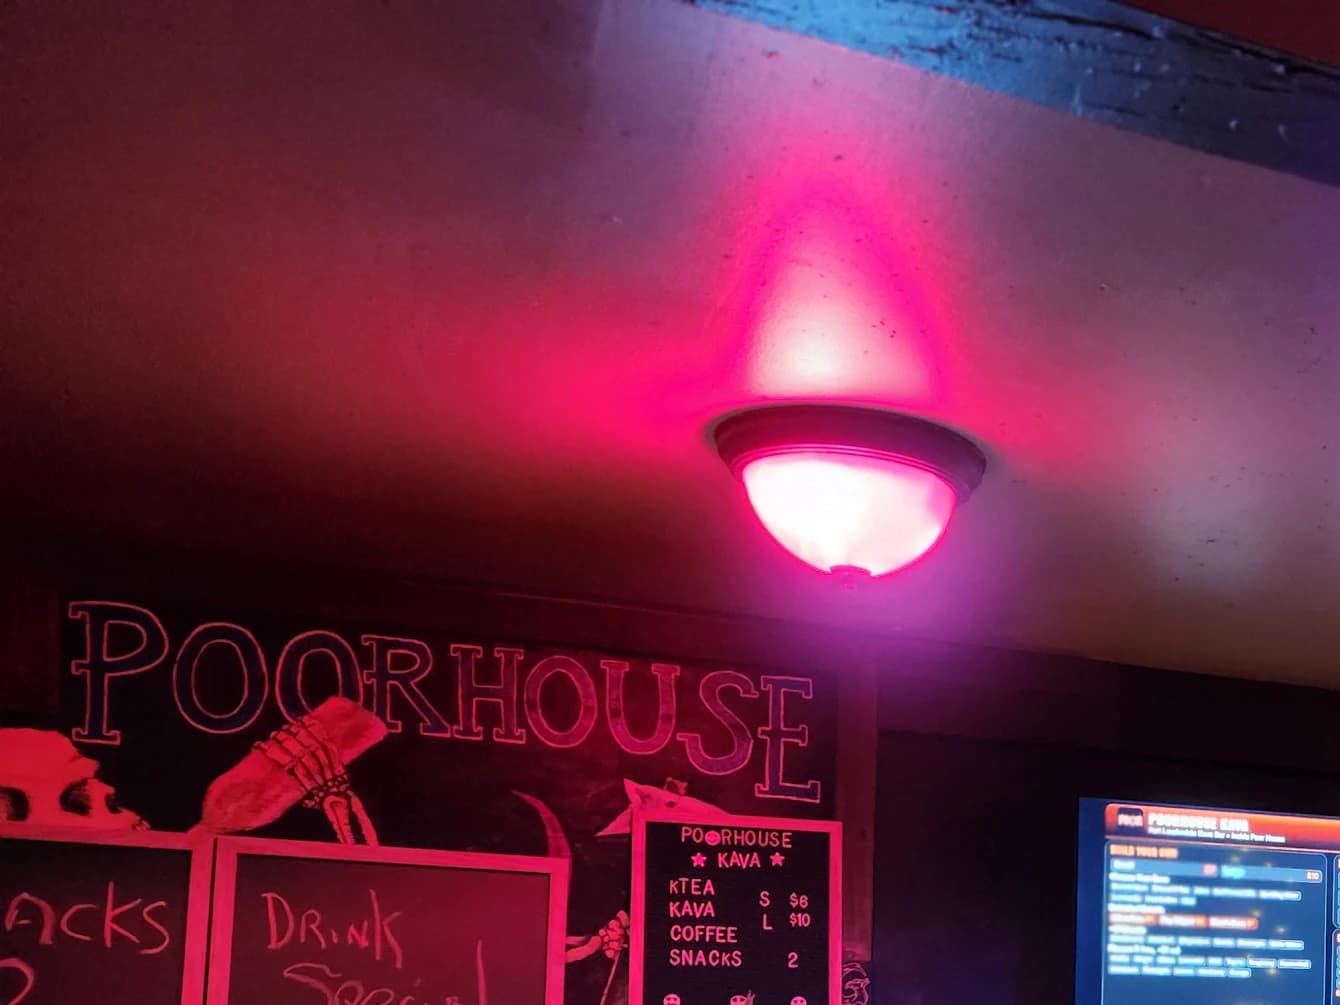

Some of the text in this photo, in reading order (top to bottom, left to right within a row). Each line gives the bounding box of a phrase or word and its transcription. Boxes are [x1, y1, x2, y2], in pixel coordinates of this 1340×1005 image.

[67, 600, 822, 803] POORHOUSE
[718, 851, 761, 868] KAVA
[759, 891, 770, 907] S
[669, 901, 715, 919] KAVA
[763, 914, 773, 931] L
[789, 912, 811, 928] $10
[670, 925, 738, 944] COFFEE
[669, 949, 743, 968] SNACKS
[787, 952, 799, 969] 2
